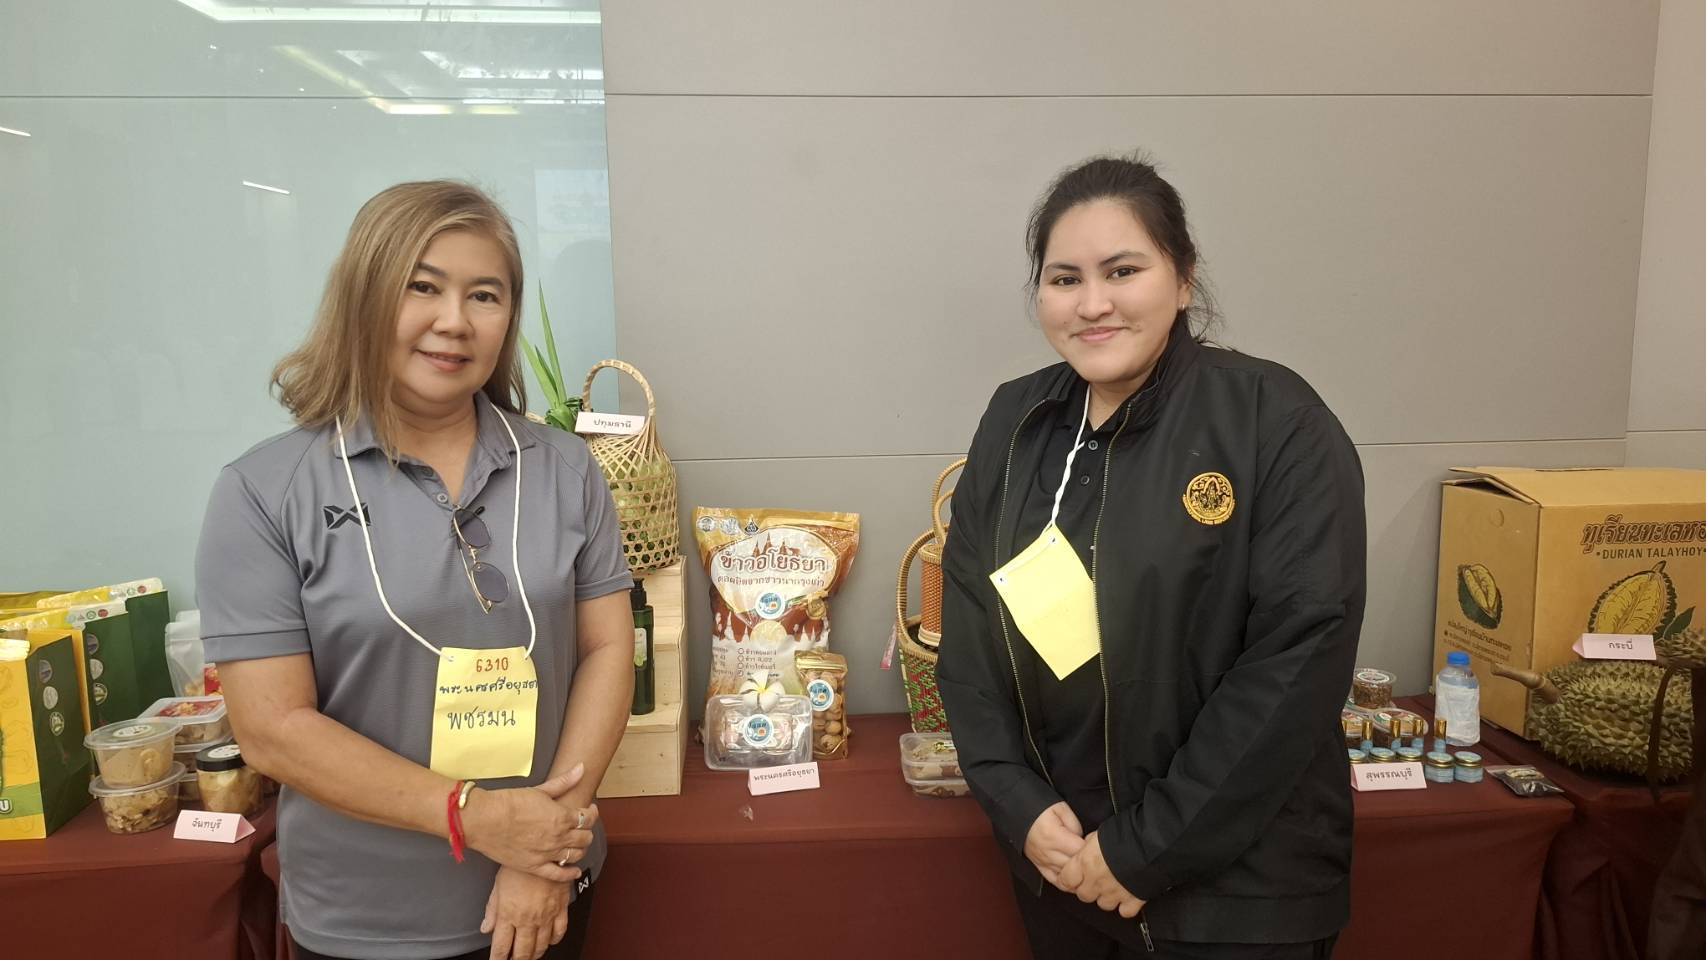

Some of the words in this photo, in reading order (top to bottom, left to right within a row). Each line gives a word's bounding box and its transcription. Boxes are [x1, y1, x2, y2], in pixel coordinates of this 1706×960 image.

[593, 419, 632, 429] ปทุมธานี
[719, 546, 828, 572] ข้าวอโยธยา
[1602, 548, 1643, 559] DURIAN
[1647, 546, 1702, 558] TALAYHOY
[1608, 638, 1633, 650] กระบี่
[475, 656, 509, 673] 6310
[447, 706, 516, 730] พชรมน
[753, 768, 815, 782] พระนครศรีอยุธยา
[1365, 767, 1413, 783] สุพรรณบุรี
[191, 817, 223, 832] จันทบุรี
